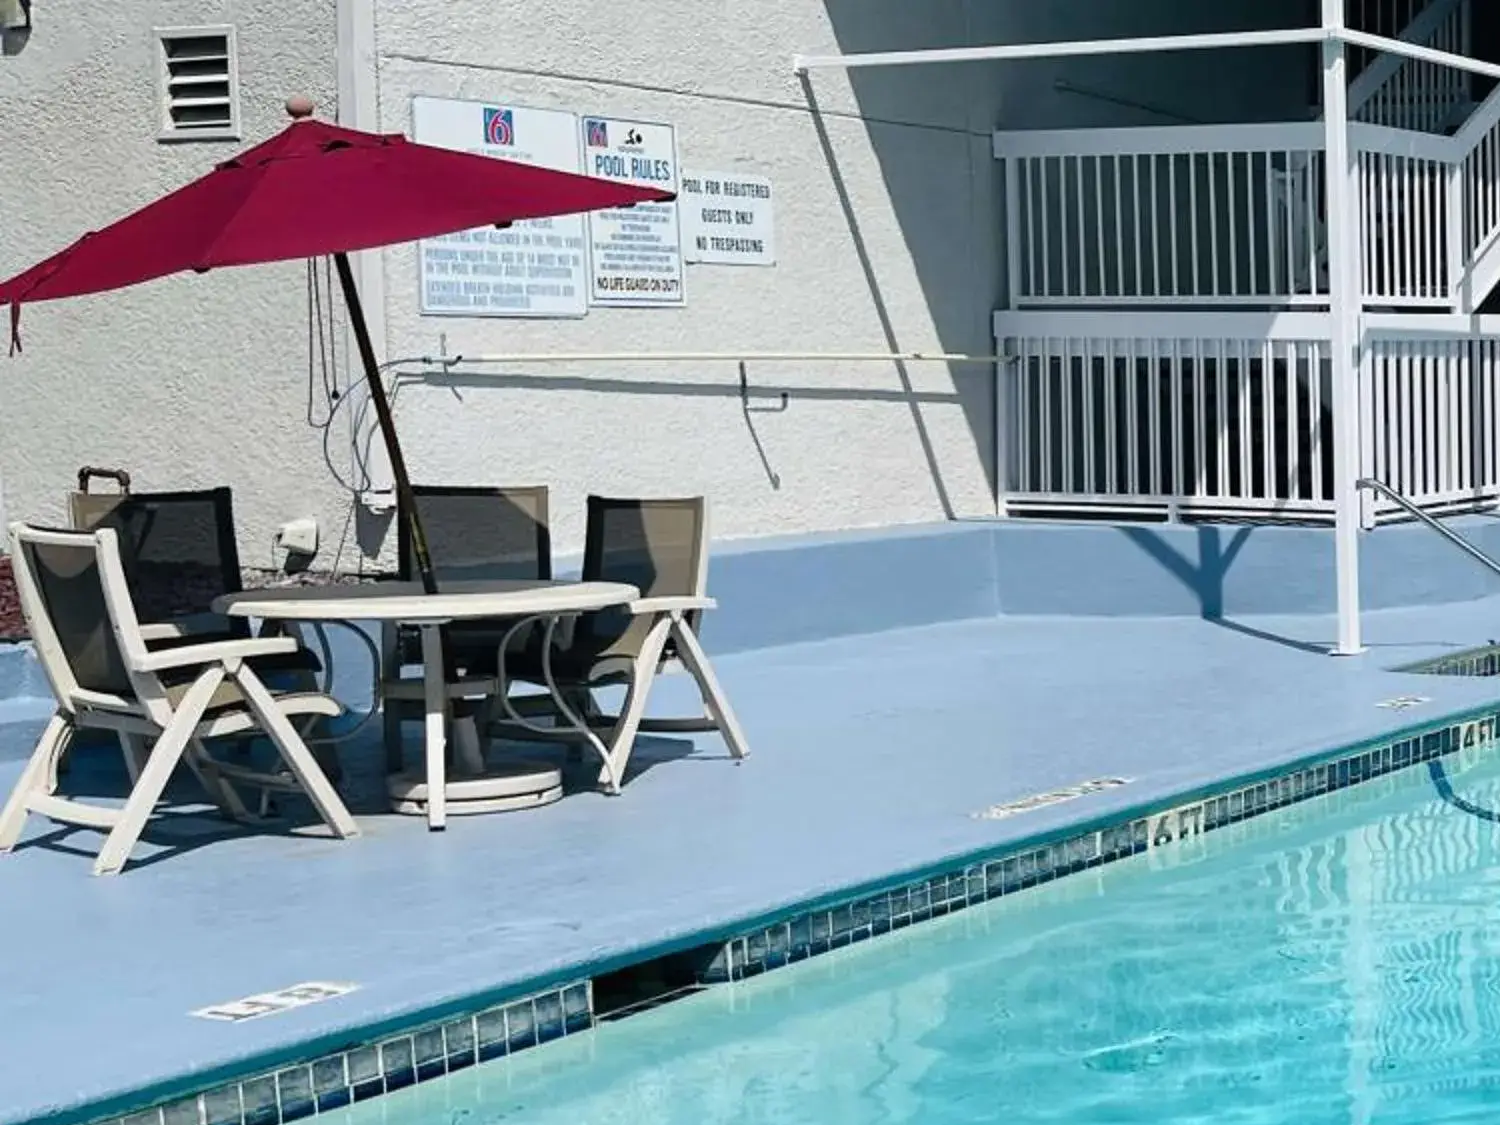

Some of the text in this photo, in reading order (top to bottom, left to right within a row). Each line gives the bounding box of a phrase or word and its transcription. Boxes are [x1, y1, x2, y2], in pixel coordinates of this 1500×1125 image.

[595, 154, 671, 180] POOL RULES
[682, 178, 770, 199] POOL FOR REGISTERED
[701, 208, 753, 225] GUESTS ONLY
[696, 236, 763, 252] NO TRESPASSING
[597, 277, 679, 291] NO LIFE GUARD ON DUTY
[1463, 718, 1494, 748] 4 FT
[1154, 805, 1202, 846] 6 FT
